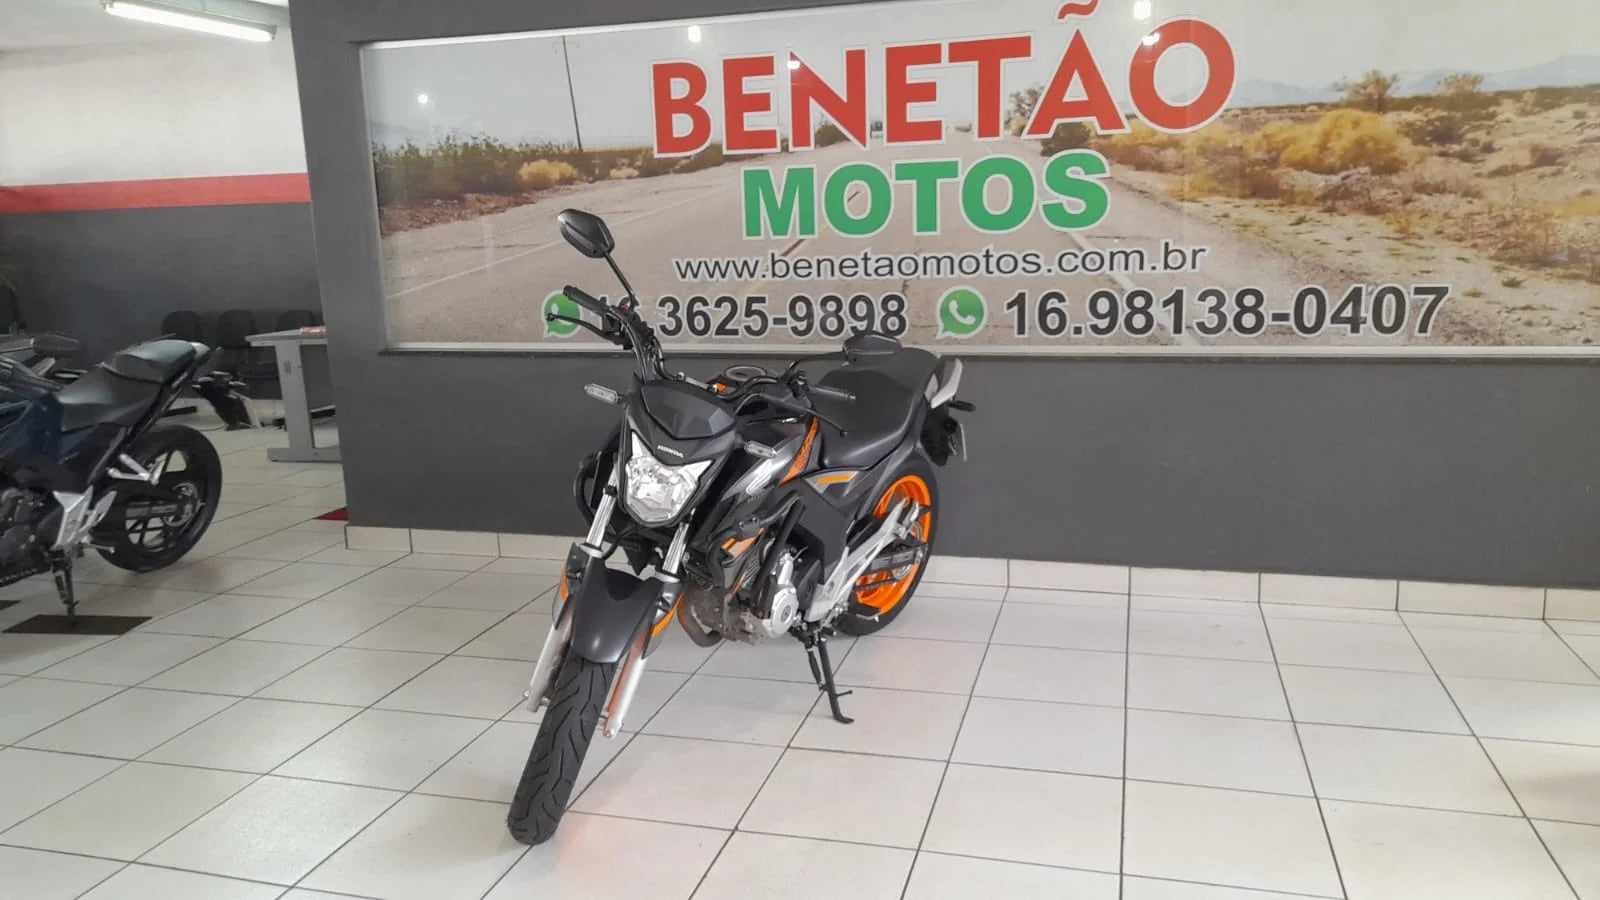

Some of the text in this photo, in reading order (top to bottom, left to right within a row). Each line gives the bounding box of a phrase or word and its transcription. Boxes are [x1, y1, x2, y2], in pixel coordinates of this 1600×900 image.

[652, 0, 1235, 154] BENETÃO
[744, 154, 1108, 237] MOTOS
[674, 242, 1207, 279] www.benetaomotos.com.br
[1006, 286, 1450, 337] 16.98138-0407
